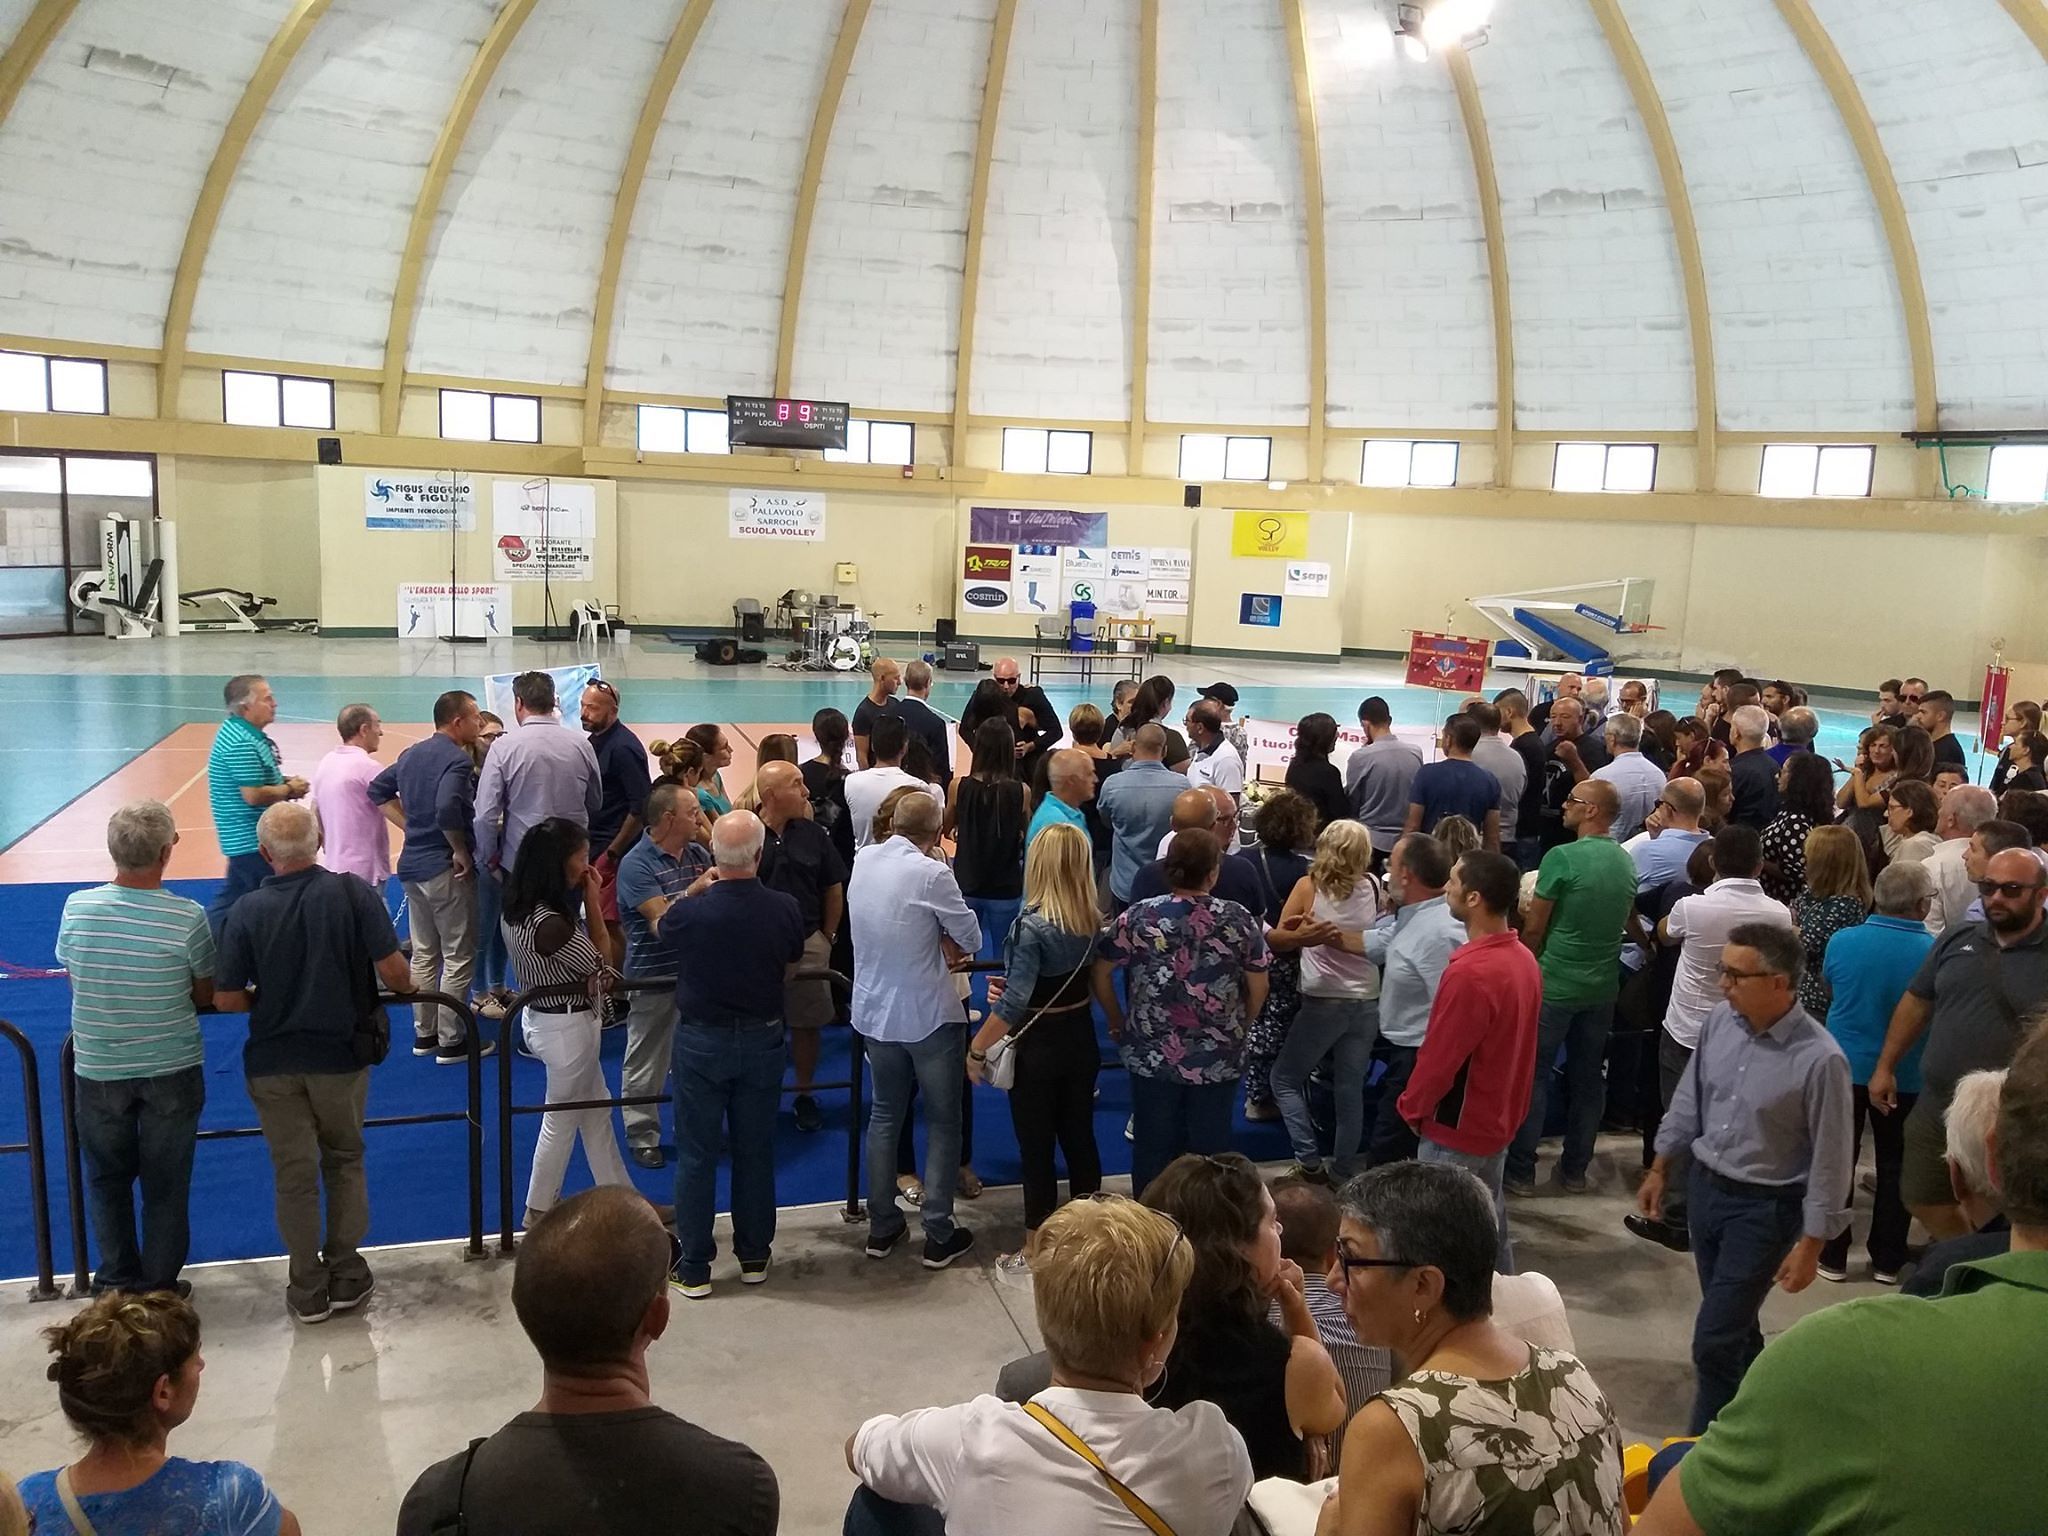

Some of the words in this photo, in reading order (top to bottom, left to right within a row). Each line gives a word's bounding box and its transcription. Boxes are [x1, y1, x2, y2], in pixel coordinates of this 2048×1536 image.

[779, 404, 788, 420] 8
[800, 405, 810, 421] 9
[395, 484, 423, 493] FIGUS
[404, 494, 414, 502] &
[752, 508, 804, 517] PALLAVOLO
[757, 518, 798, 526] SARROCH
[739, 526, 777, 536] SCUOLA
[780, 528, 816, 537] VOLLEY
[106, 531, 116, 592] NEWFORM
[966, 591, 1005, 602] cosmin
